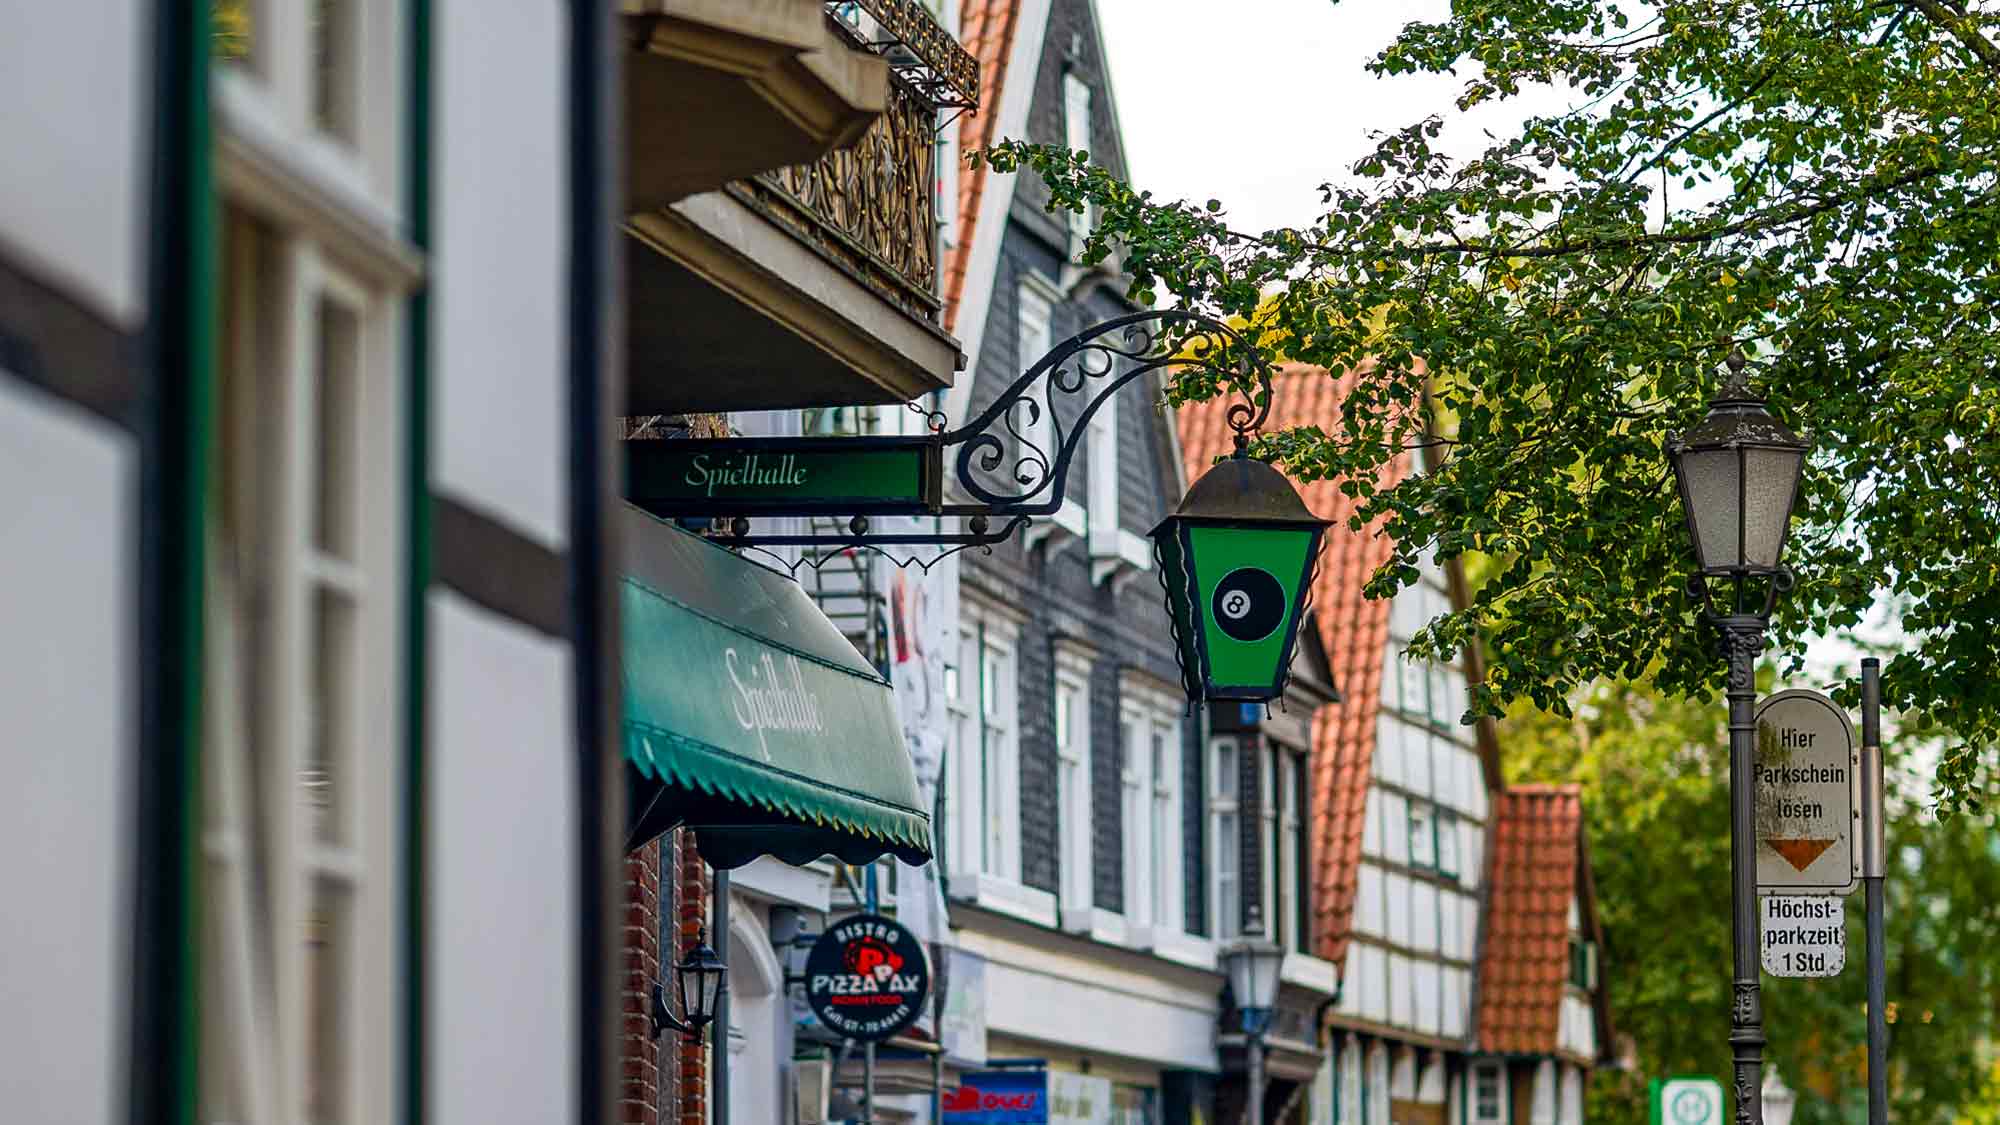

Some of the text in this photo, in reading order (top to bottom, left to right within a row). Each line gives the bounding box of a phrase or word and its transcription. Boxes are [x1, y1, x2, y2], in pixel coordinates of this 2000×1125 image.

[685, 454, 807, 496] Spielhalle
[1227, 595, 1244, 614] 8
[725, 648, 824, 761] Spielhalle
[1780, 728, 1816, 748] Hier
[1754, 763, 1845, 785] Parkschein
[1777, 799, 1822, 819] lösen
[1768, 898, 1837, 919] Höchst-
[835, 923, 899, 943] BISTRO
[1766, 926, 1840, 949] parkzeit
[1783, 952, 1825, 972] 1 Std
